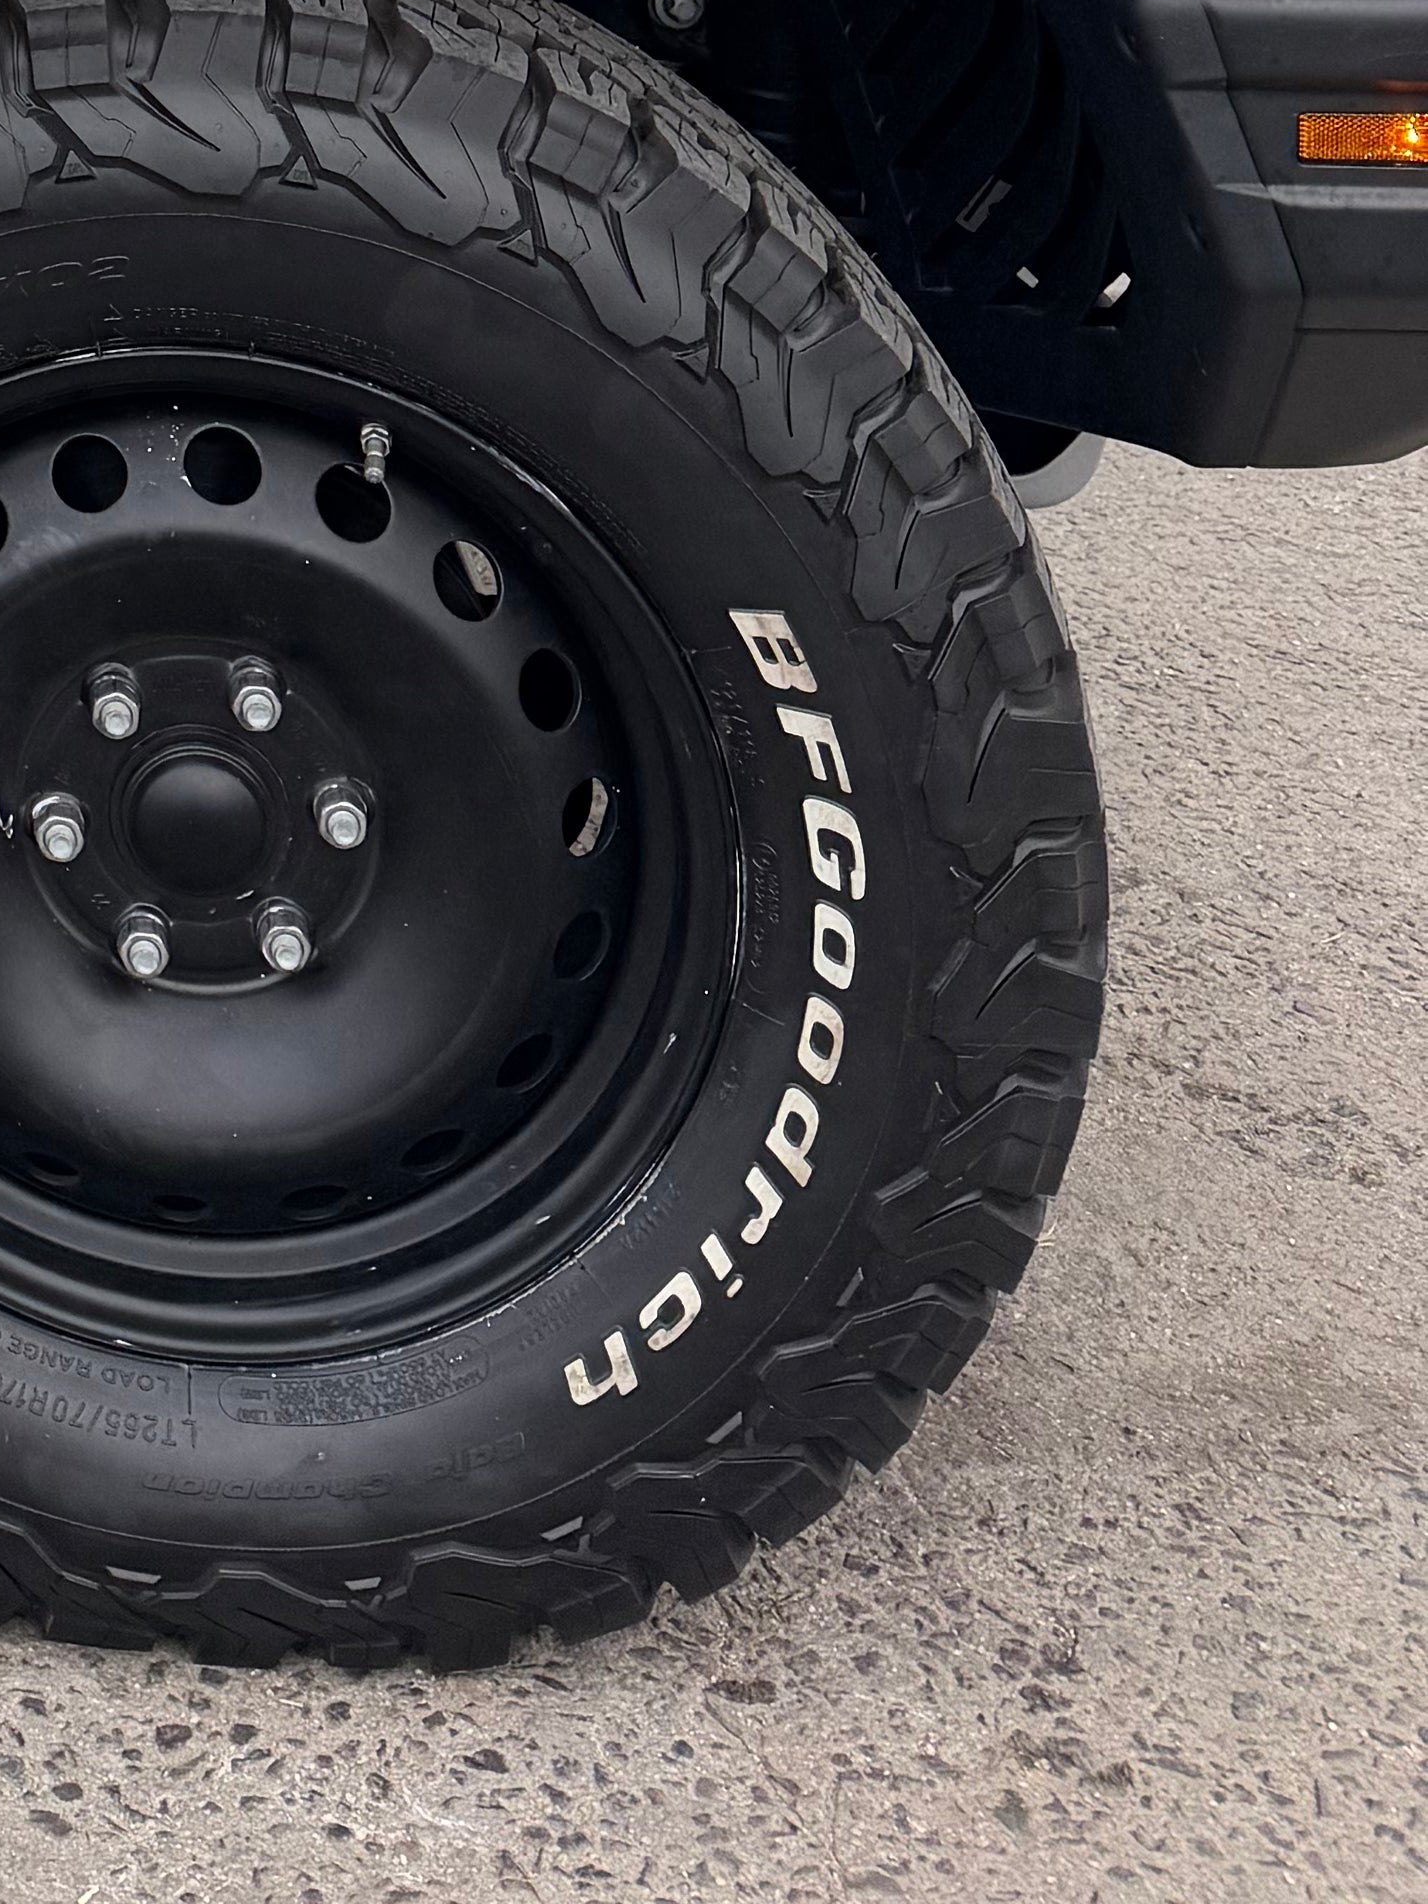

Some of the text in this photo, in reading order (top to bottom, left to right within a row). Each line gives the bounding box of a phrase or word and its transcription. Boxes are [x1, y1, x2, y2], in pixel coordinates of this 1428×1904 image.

[564, 606, 866, 1411] BFGoodrich
[6, 1334, 94, 1379] RANGE
[101, 1367, 172, 1394] LOAD
